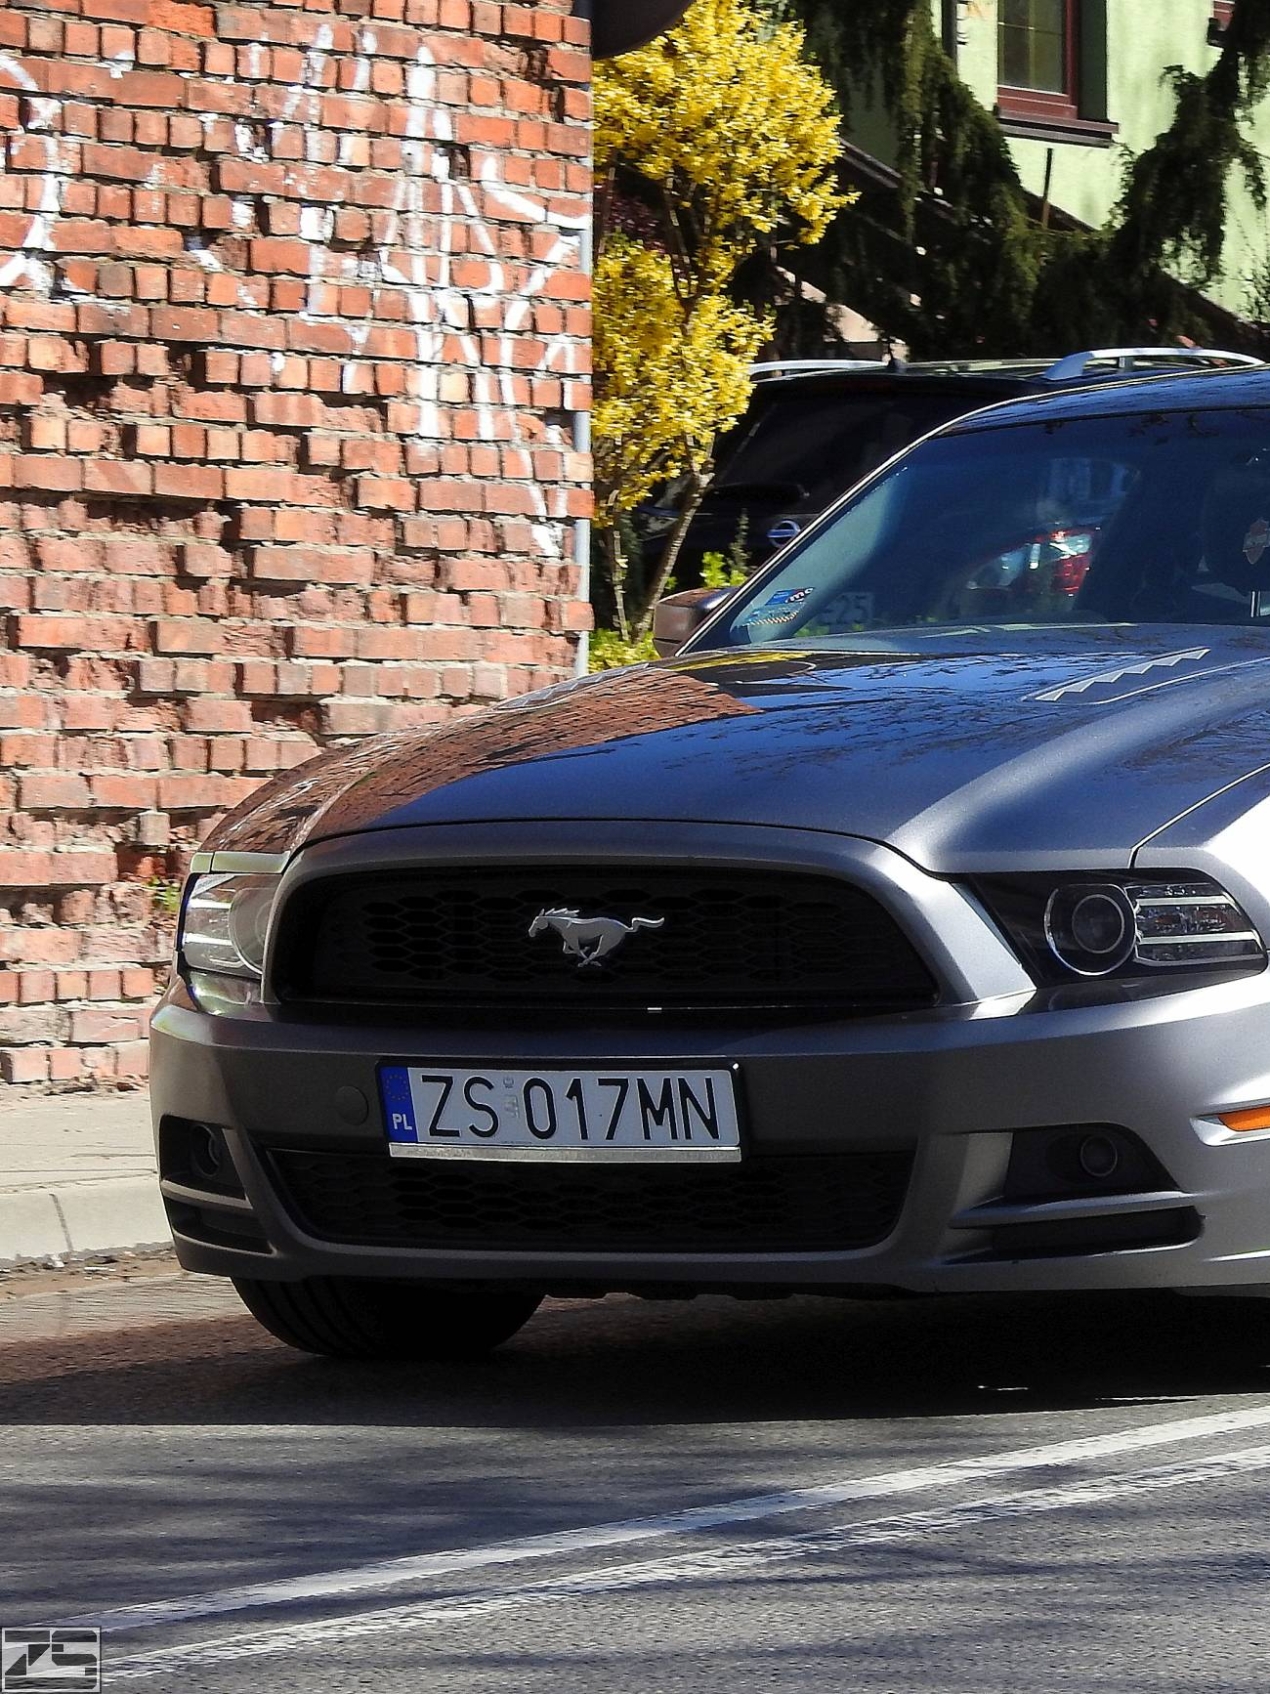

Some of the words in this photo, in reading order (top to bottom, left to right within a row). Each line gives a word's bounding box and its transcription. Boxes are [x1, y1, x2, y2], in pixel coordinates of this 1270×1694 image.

[392, 1113, 413, 1131] PL
[421, 1074, 499, 1138] ZS
[522, 1077, 721, 1141] 017MN
